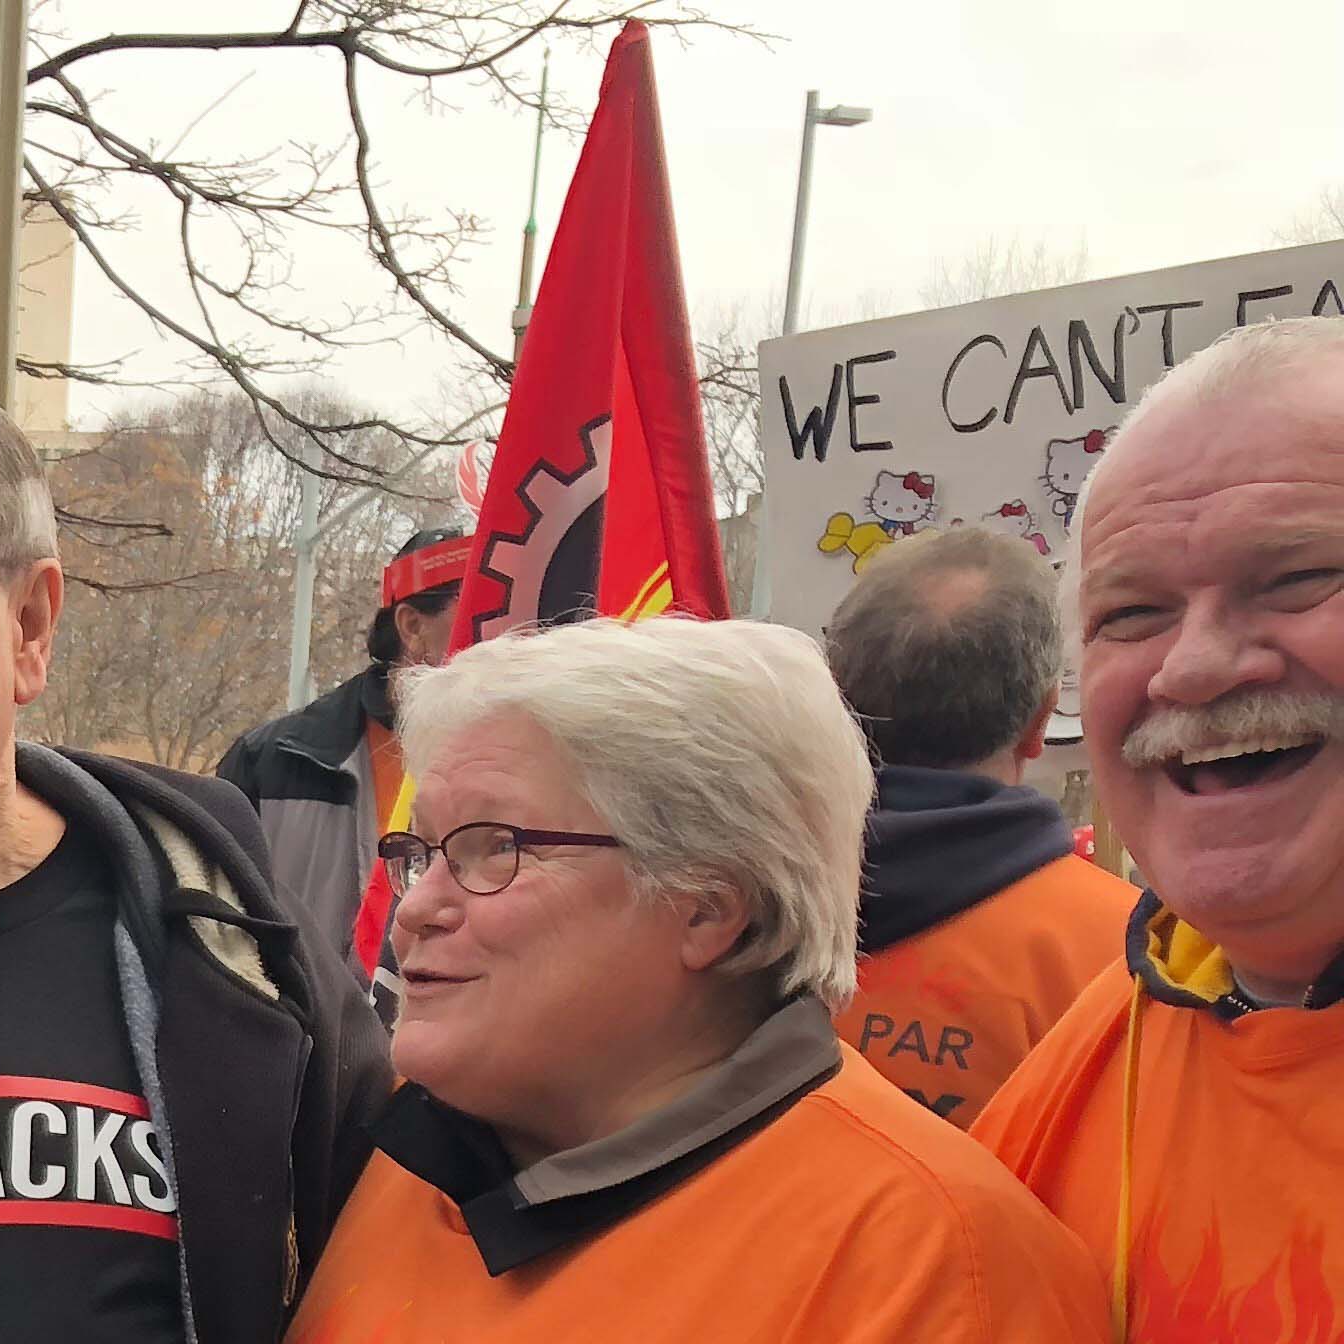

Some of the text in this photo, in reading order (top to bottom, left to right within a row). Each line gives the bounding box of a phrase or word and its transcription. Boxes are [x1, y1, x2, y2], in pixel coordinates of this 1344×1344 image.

[779, 300, 1204, 463] WE CAN'T
[859, 1012, 974, 1070] PAR
